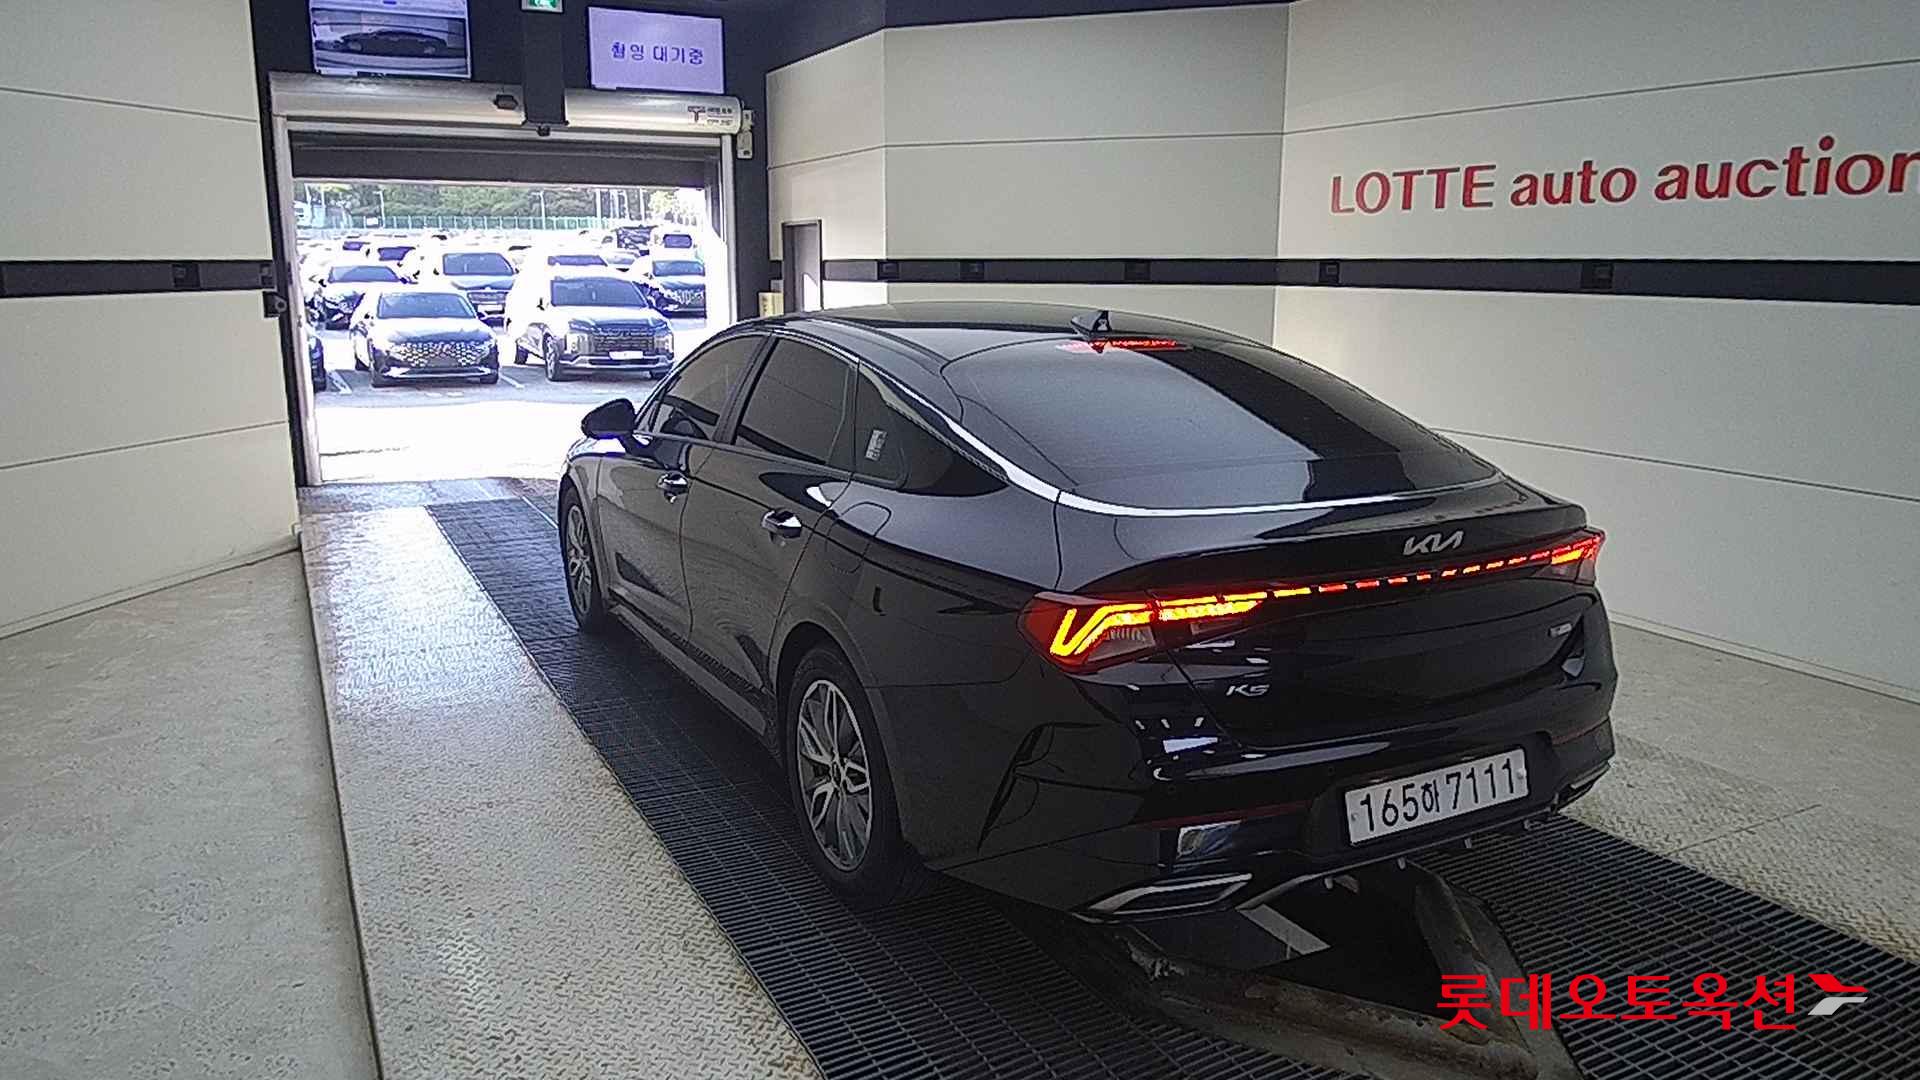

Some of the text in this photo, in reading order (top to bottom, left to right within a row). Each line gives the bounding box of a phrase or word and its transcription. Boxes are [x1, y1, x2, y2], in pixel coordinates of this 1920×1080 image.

[652, 45, 704, 65] 대기중
[1331, 164, 1496, 214] LOTTE
[1510, 160, 1638, 206] auto
[1226, 684, 1270, 696] K5
